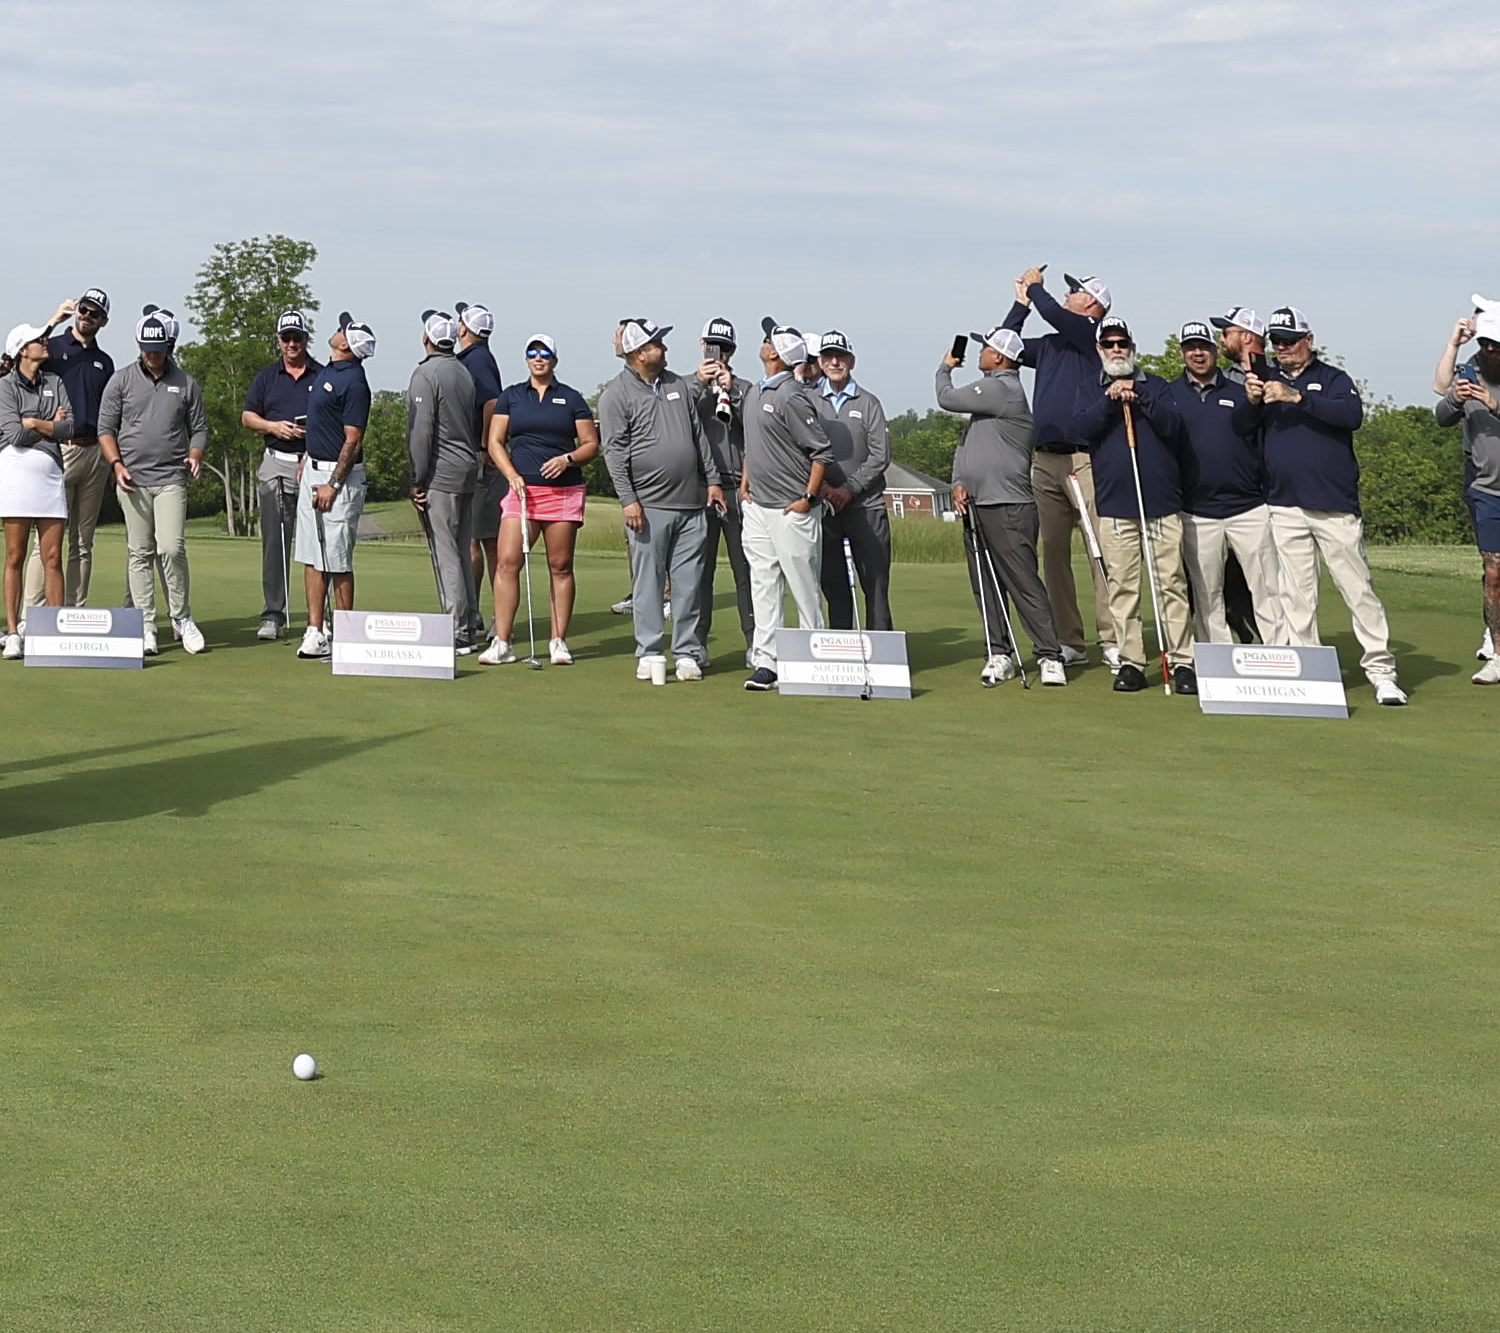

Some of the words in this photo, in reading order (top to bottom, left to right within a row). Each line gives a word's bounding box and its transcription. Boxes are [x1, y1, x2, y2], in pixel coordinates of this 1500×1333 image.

[282, 315, 301, 325] HOPE
[143, 327, 163, 338] HOPE
[822, 334, 843, 345] HOPE
[66, 612, 86, 620] PGA
[820, 637, 843, 645] PGA
[59, 642, 110, 651] GEORGIA
[365, 649, 422, 660] NEBRASKA
[1243, 652, 1268, 660] PGA
[811, 674, 875, 684] CALIFORNA
[1235, 685, 1307, 697] MICHIGAN
